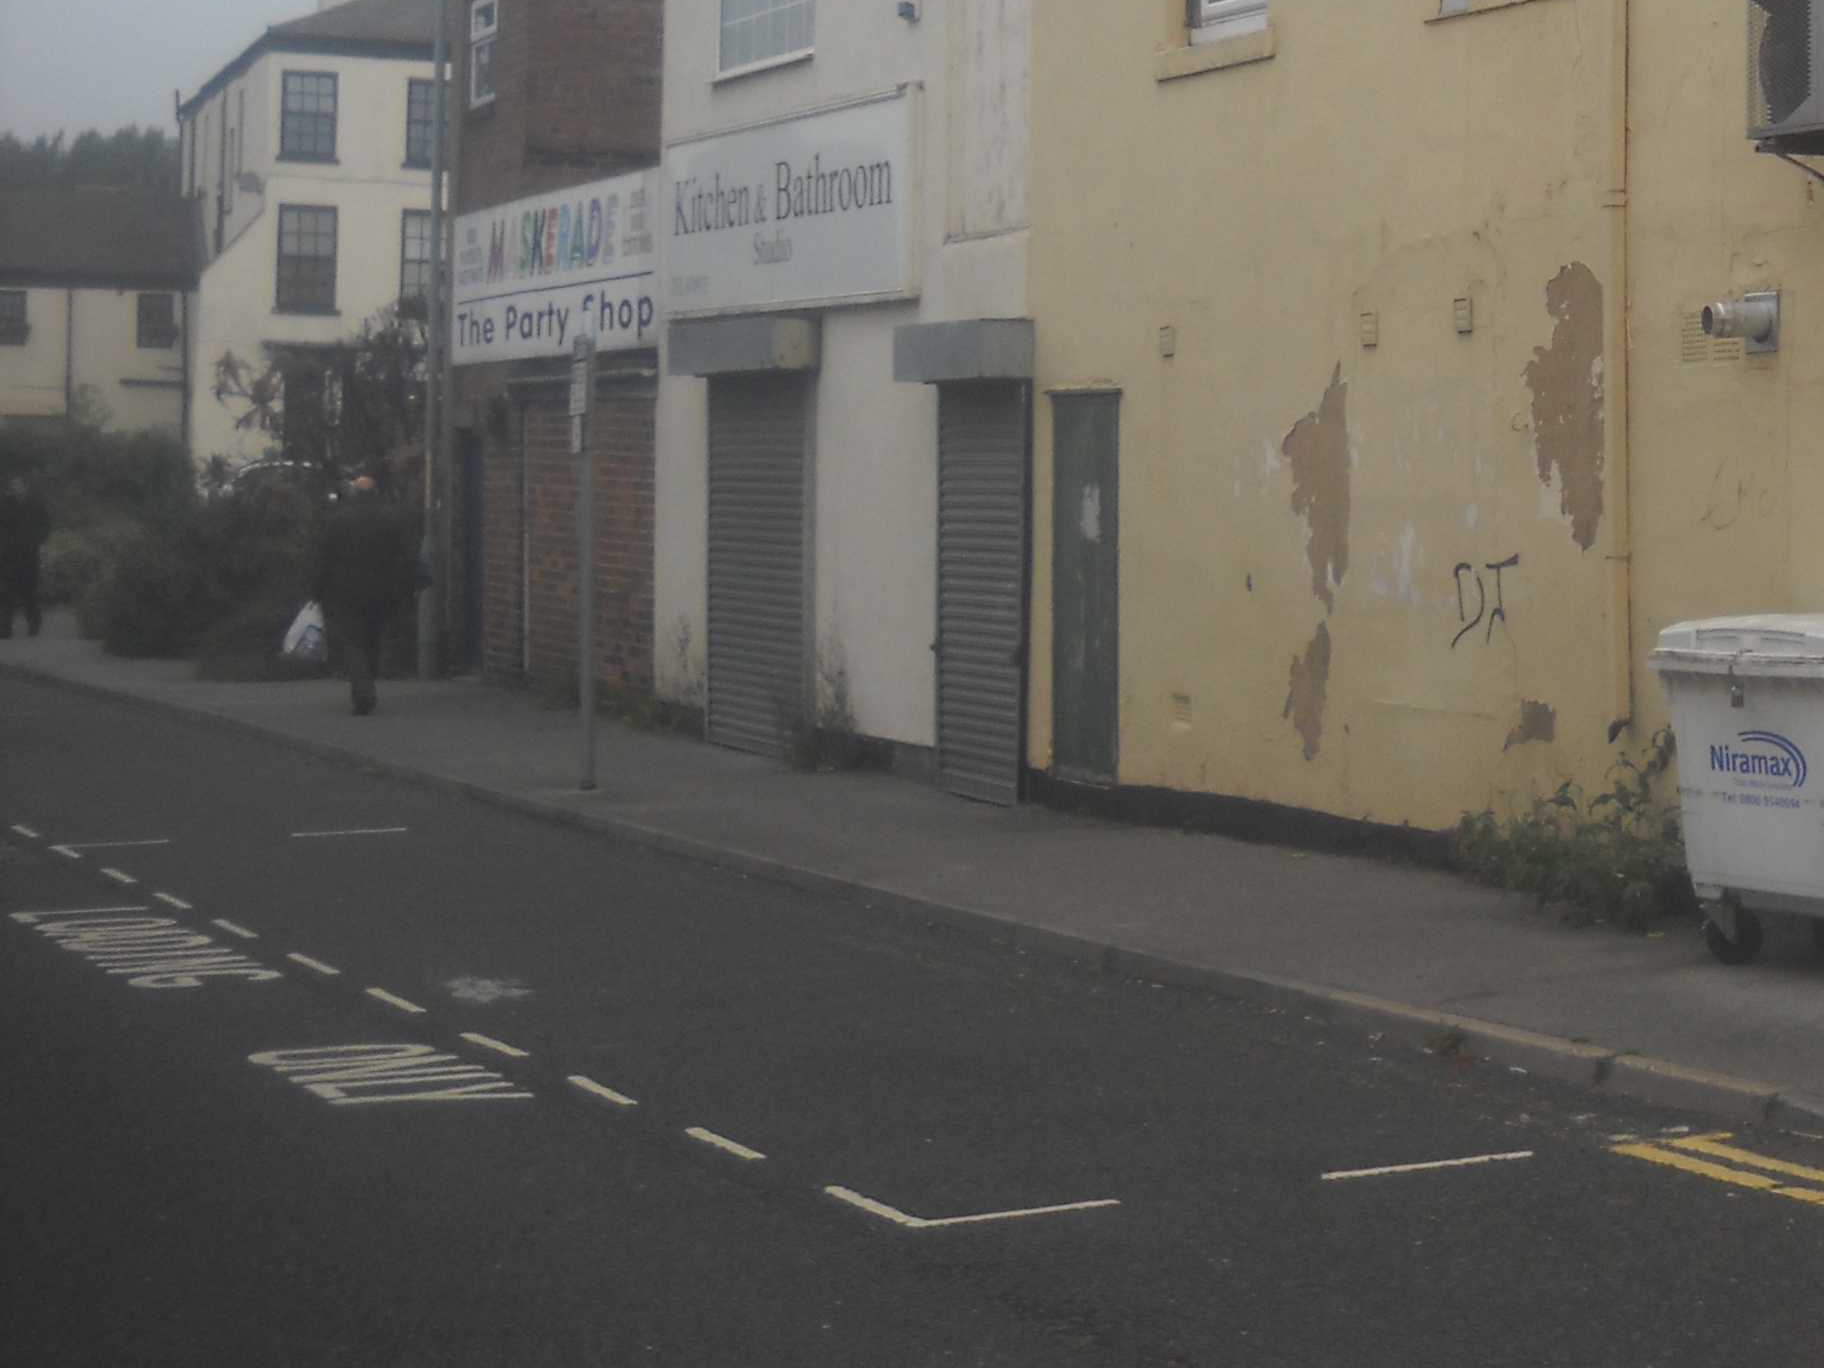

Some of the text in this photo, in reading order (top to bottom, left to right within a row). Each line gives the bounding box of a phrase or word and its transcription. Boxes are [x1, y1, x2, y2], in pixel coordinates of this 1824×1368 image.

[673, 173, 750, 236] Kitchen
[753, 183, 767, 224] &
[774, 153, 893, 221] Bathroom
[486, 193, 619, 284] MASKERADE
[457, 310, 494, 347] The
[505, 301, 570, 347] Party
[1709, 744, 1794, 778] Niramax
